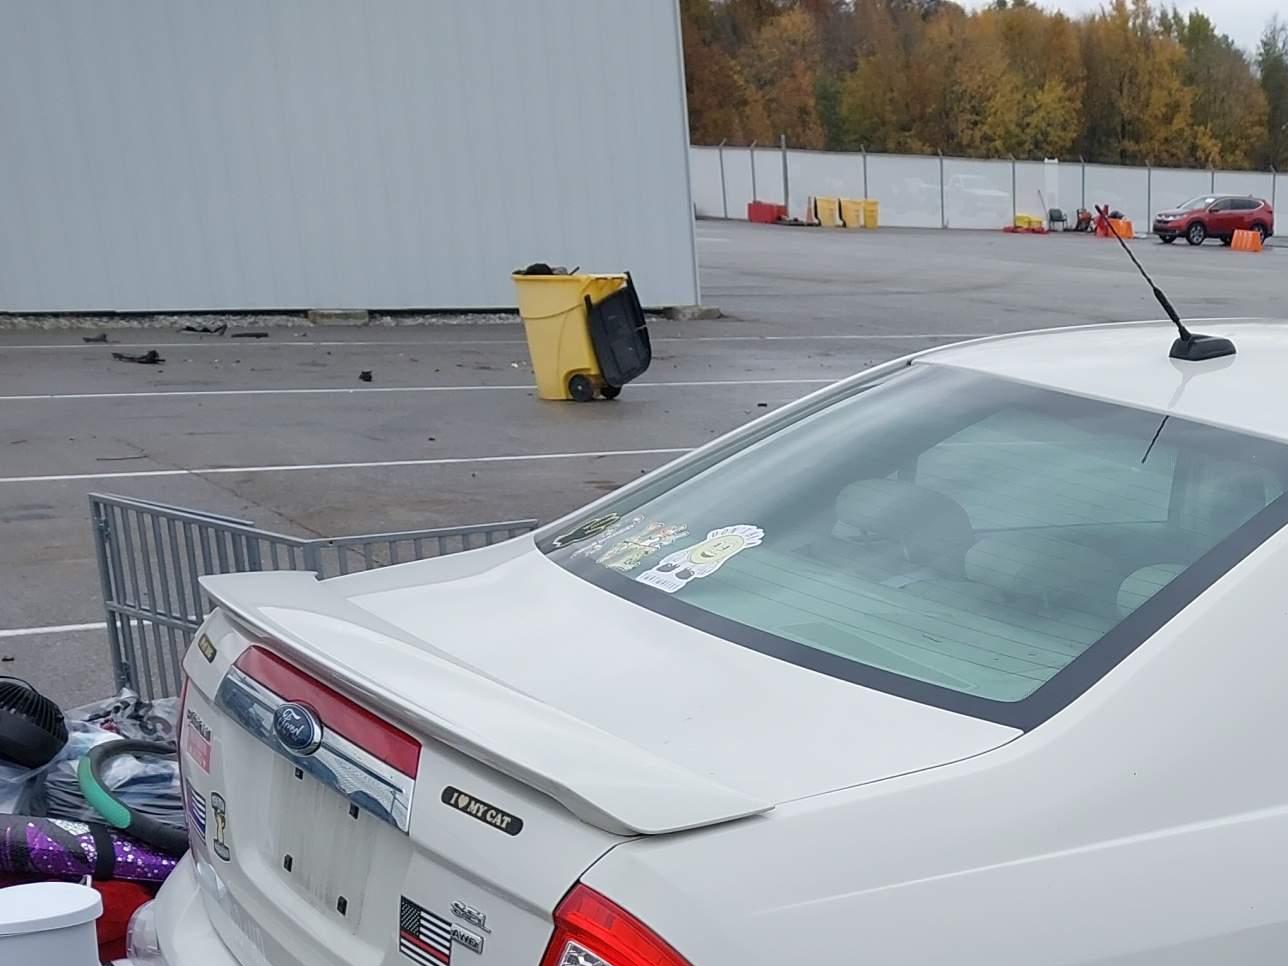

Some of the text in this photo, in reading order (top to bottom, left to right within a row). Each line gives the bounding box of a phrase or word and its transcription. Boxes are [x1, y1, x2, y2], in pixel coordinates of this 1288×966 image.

[278, 708, 304, 738] Ford
[467, 798, 488, 817] MY
[486, 810, 512, 828] CAT
